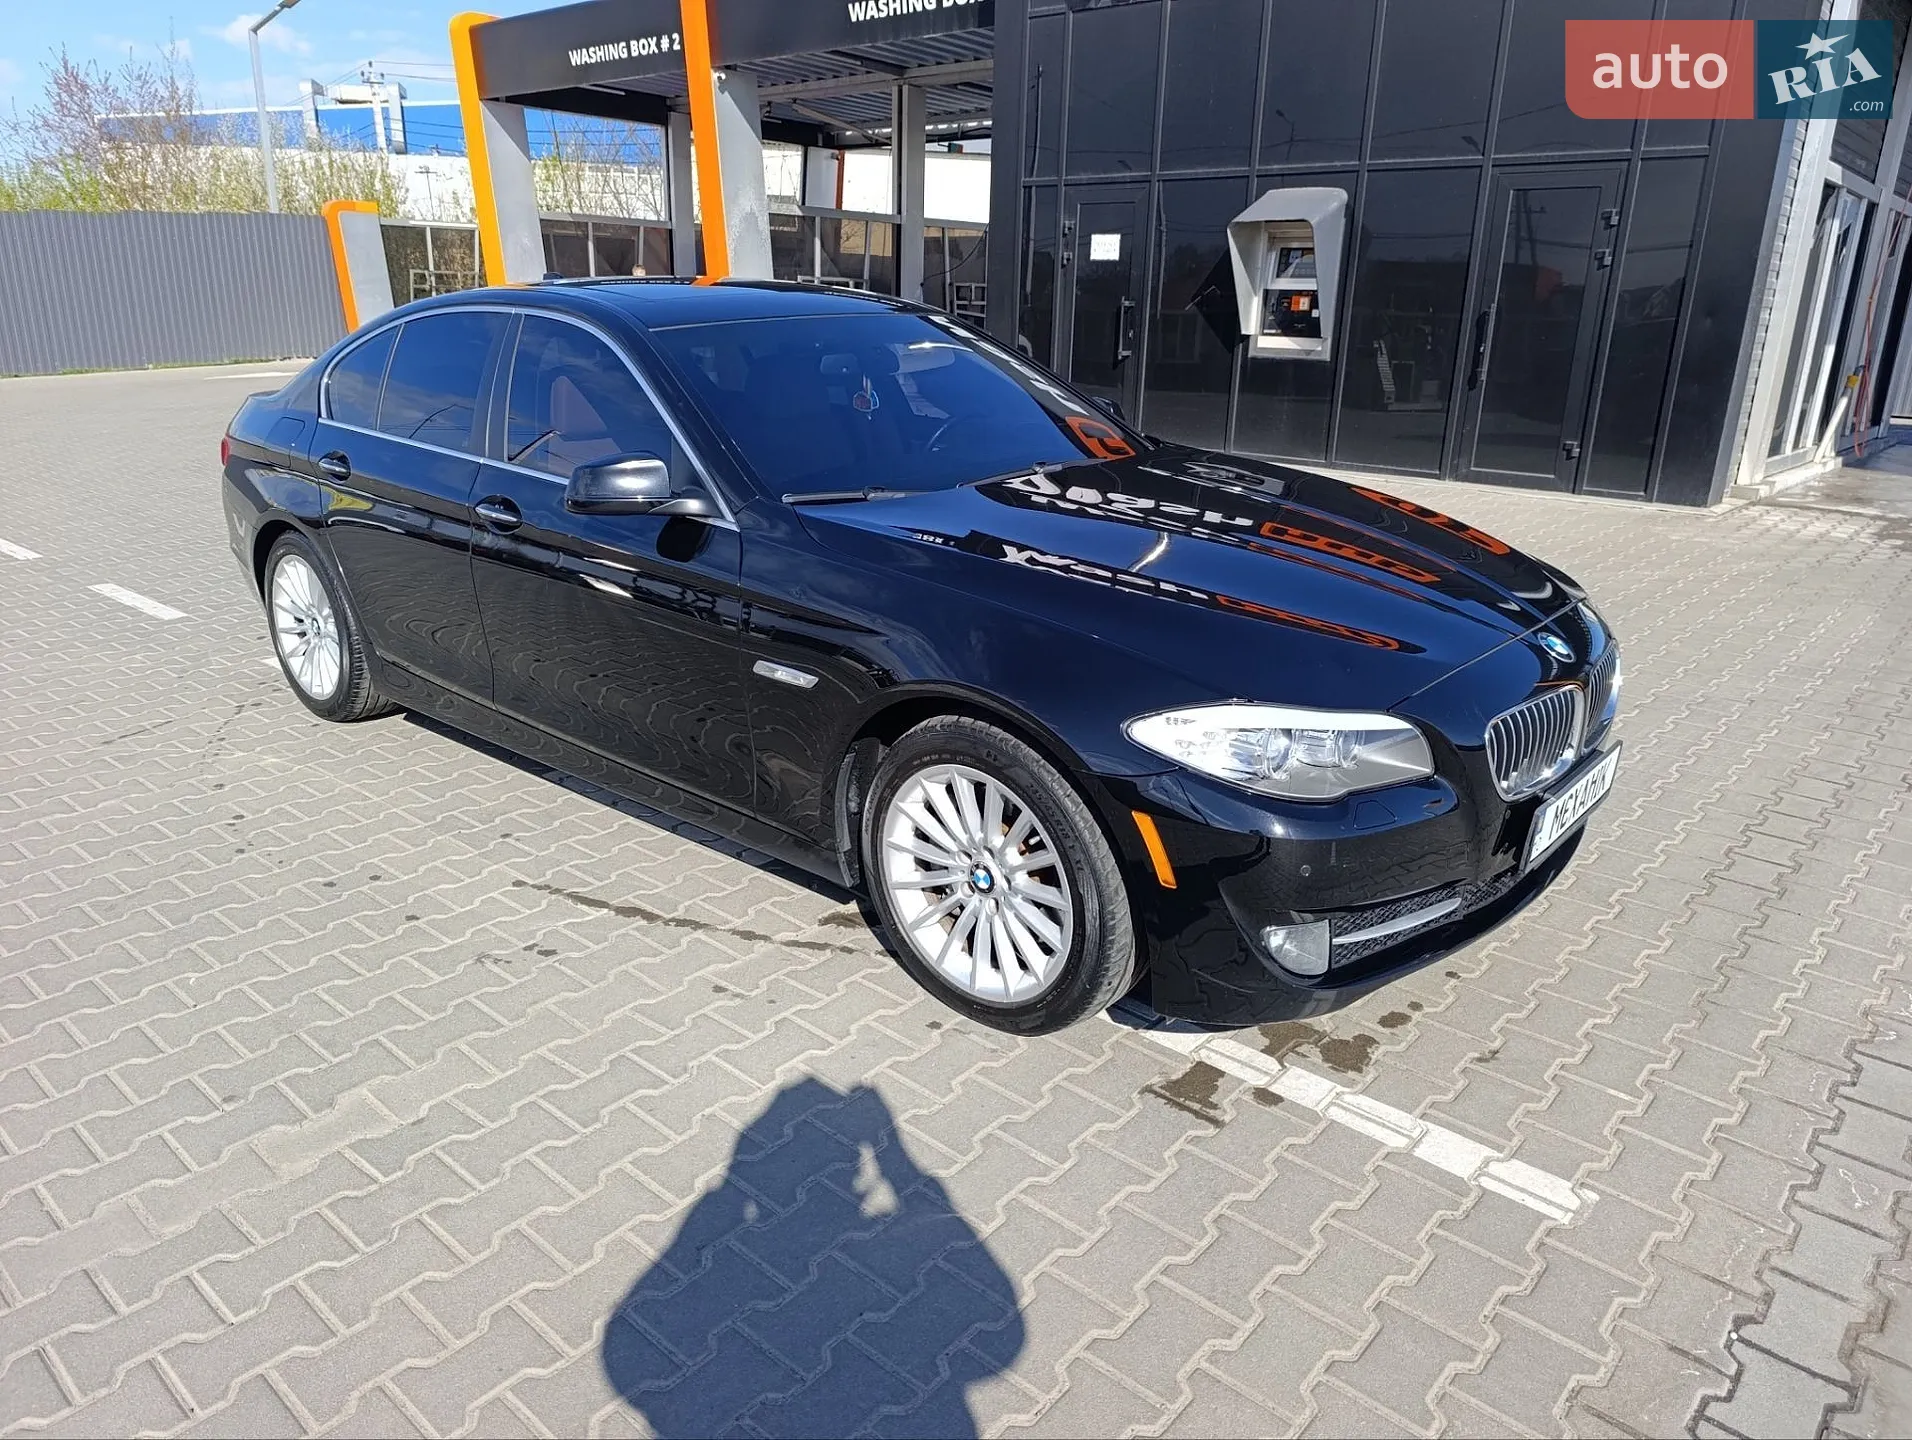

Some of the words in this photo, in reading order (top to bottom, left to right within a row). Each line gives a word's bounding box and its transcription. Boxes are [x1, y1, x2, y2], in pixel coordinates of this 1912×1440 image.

[848, 0, 937, 23] WASHING
[568, 41, 628, 67] WASHING
[629, 36, 659, 57] BOX
[660, 34, 670, 52] #
[671, 32, 681, 51] 2
[1548, 757, 1614, 841] МЕХАНІК
